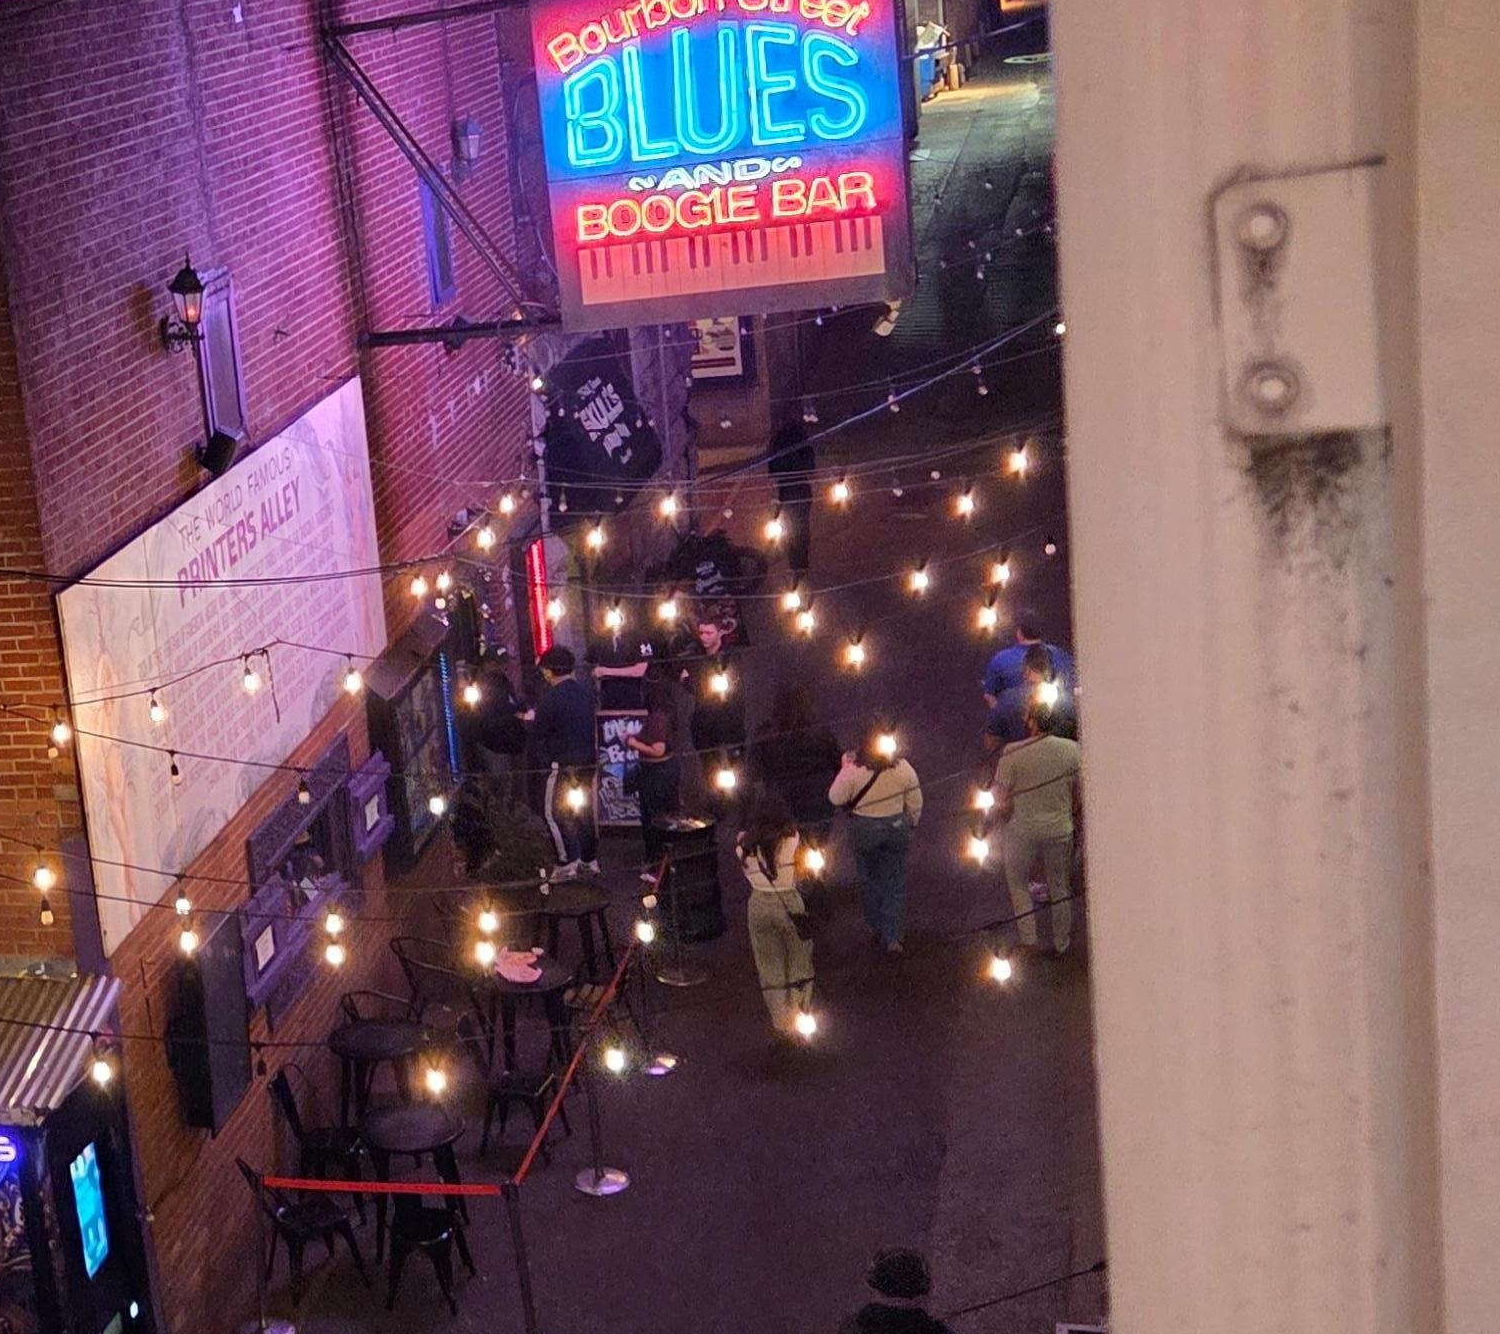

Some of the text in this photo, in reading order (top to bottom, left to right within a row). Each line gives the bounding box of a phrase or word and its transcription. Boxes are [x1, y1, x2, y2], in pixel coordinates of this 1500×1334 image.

[564, 23, 867, 166] BLUES
[577, 170, 877, 243] BOOGIE BAR
[655, 156, 773, 191] AND
[176, 474, 301, 610] PRINTER'S ALLEY
[177, 445, 292, 551] THE WORLD FAMOUS
